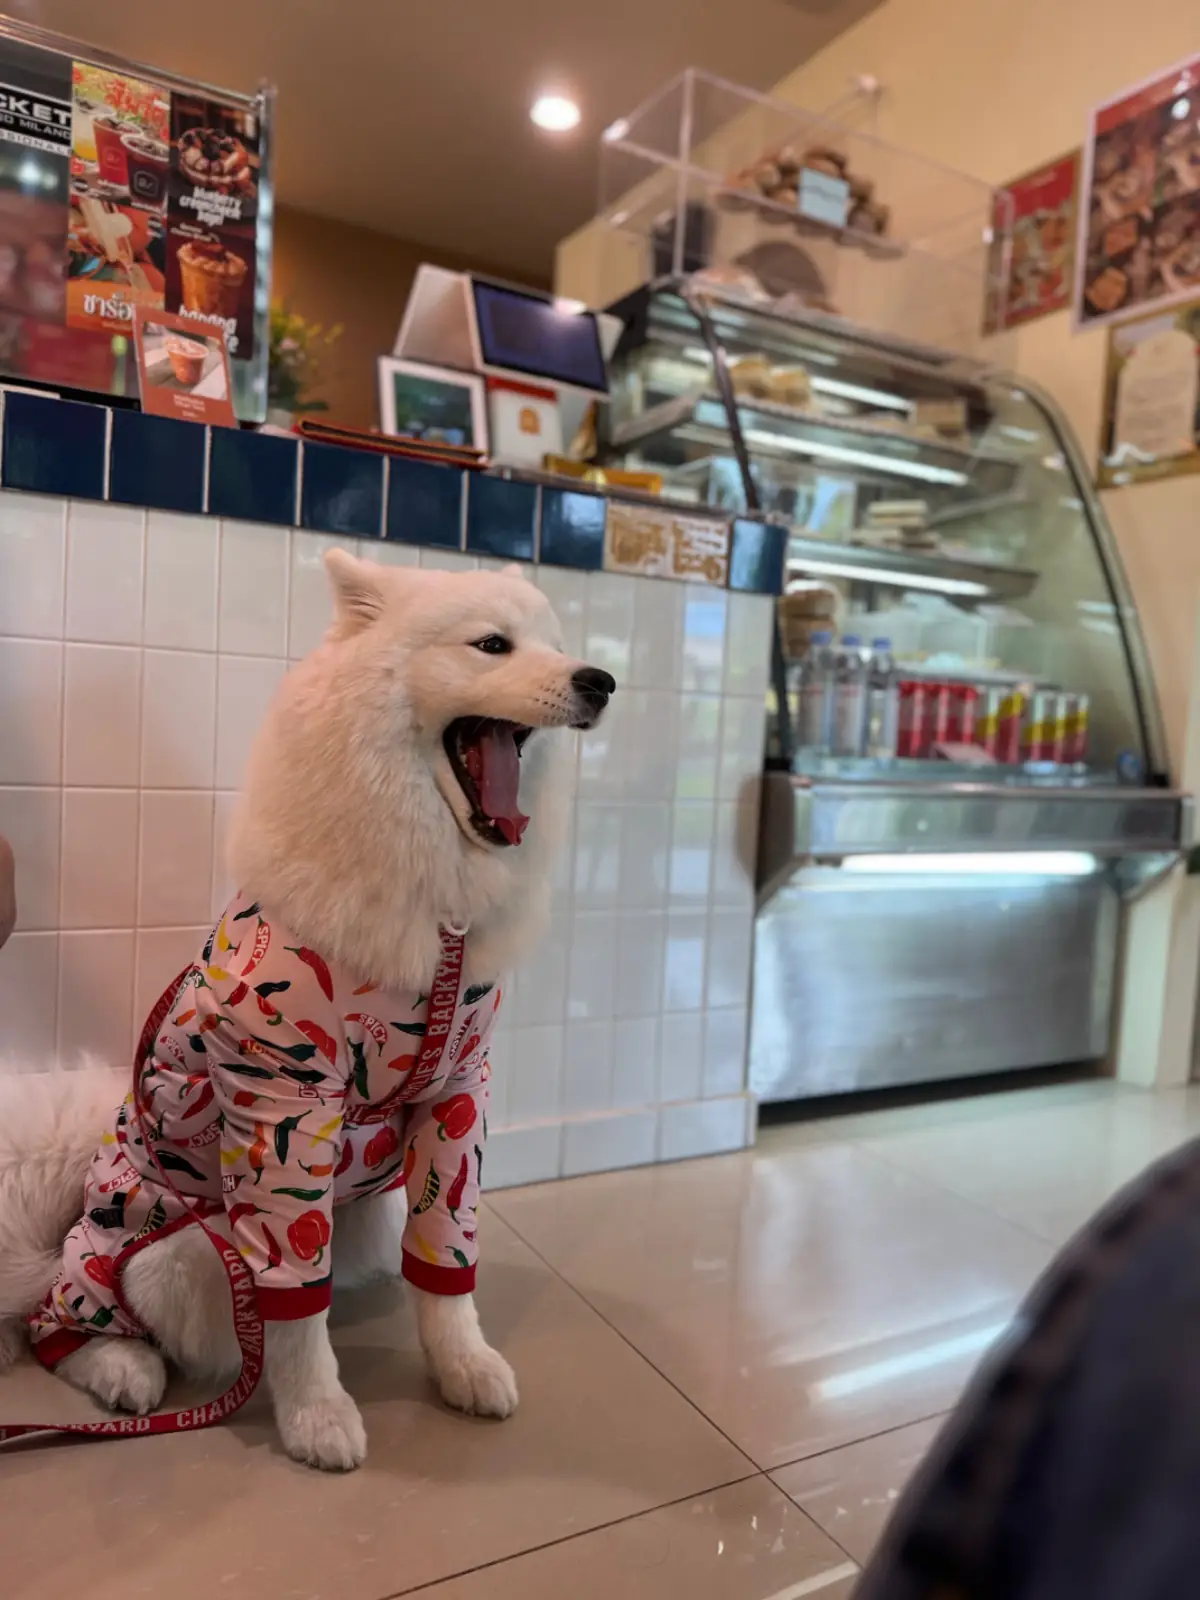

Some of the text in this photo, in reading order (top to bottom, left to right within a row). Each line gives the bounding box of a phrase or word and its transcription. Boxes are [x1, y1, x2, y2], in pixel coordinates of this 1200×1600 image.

[253, 925, 270, 965] SPICY
[428, 930, 463, 1037] BACKYAR
[357, 1014, 387, 1043] SPICY
[222, 1249, 263, 1358] BACKYARD
